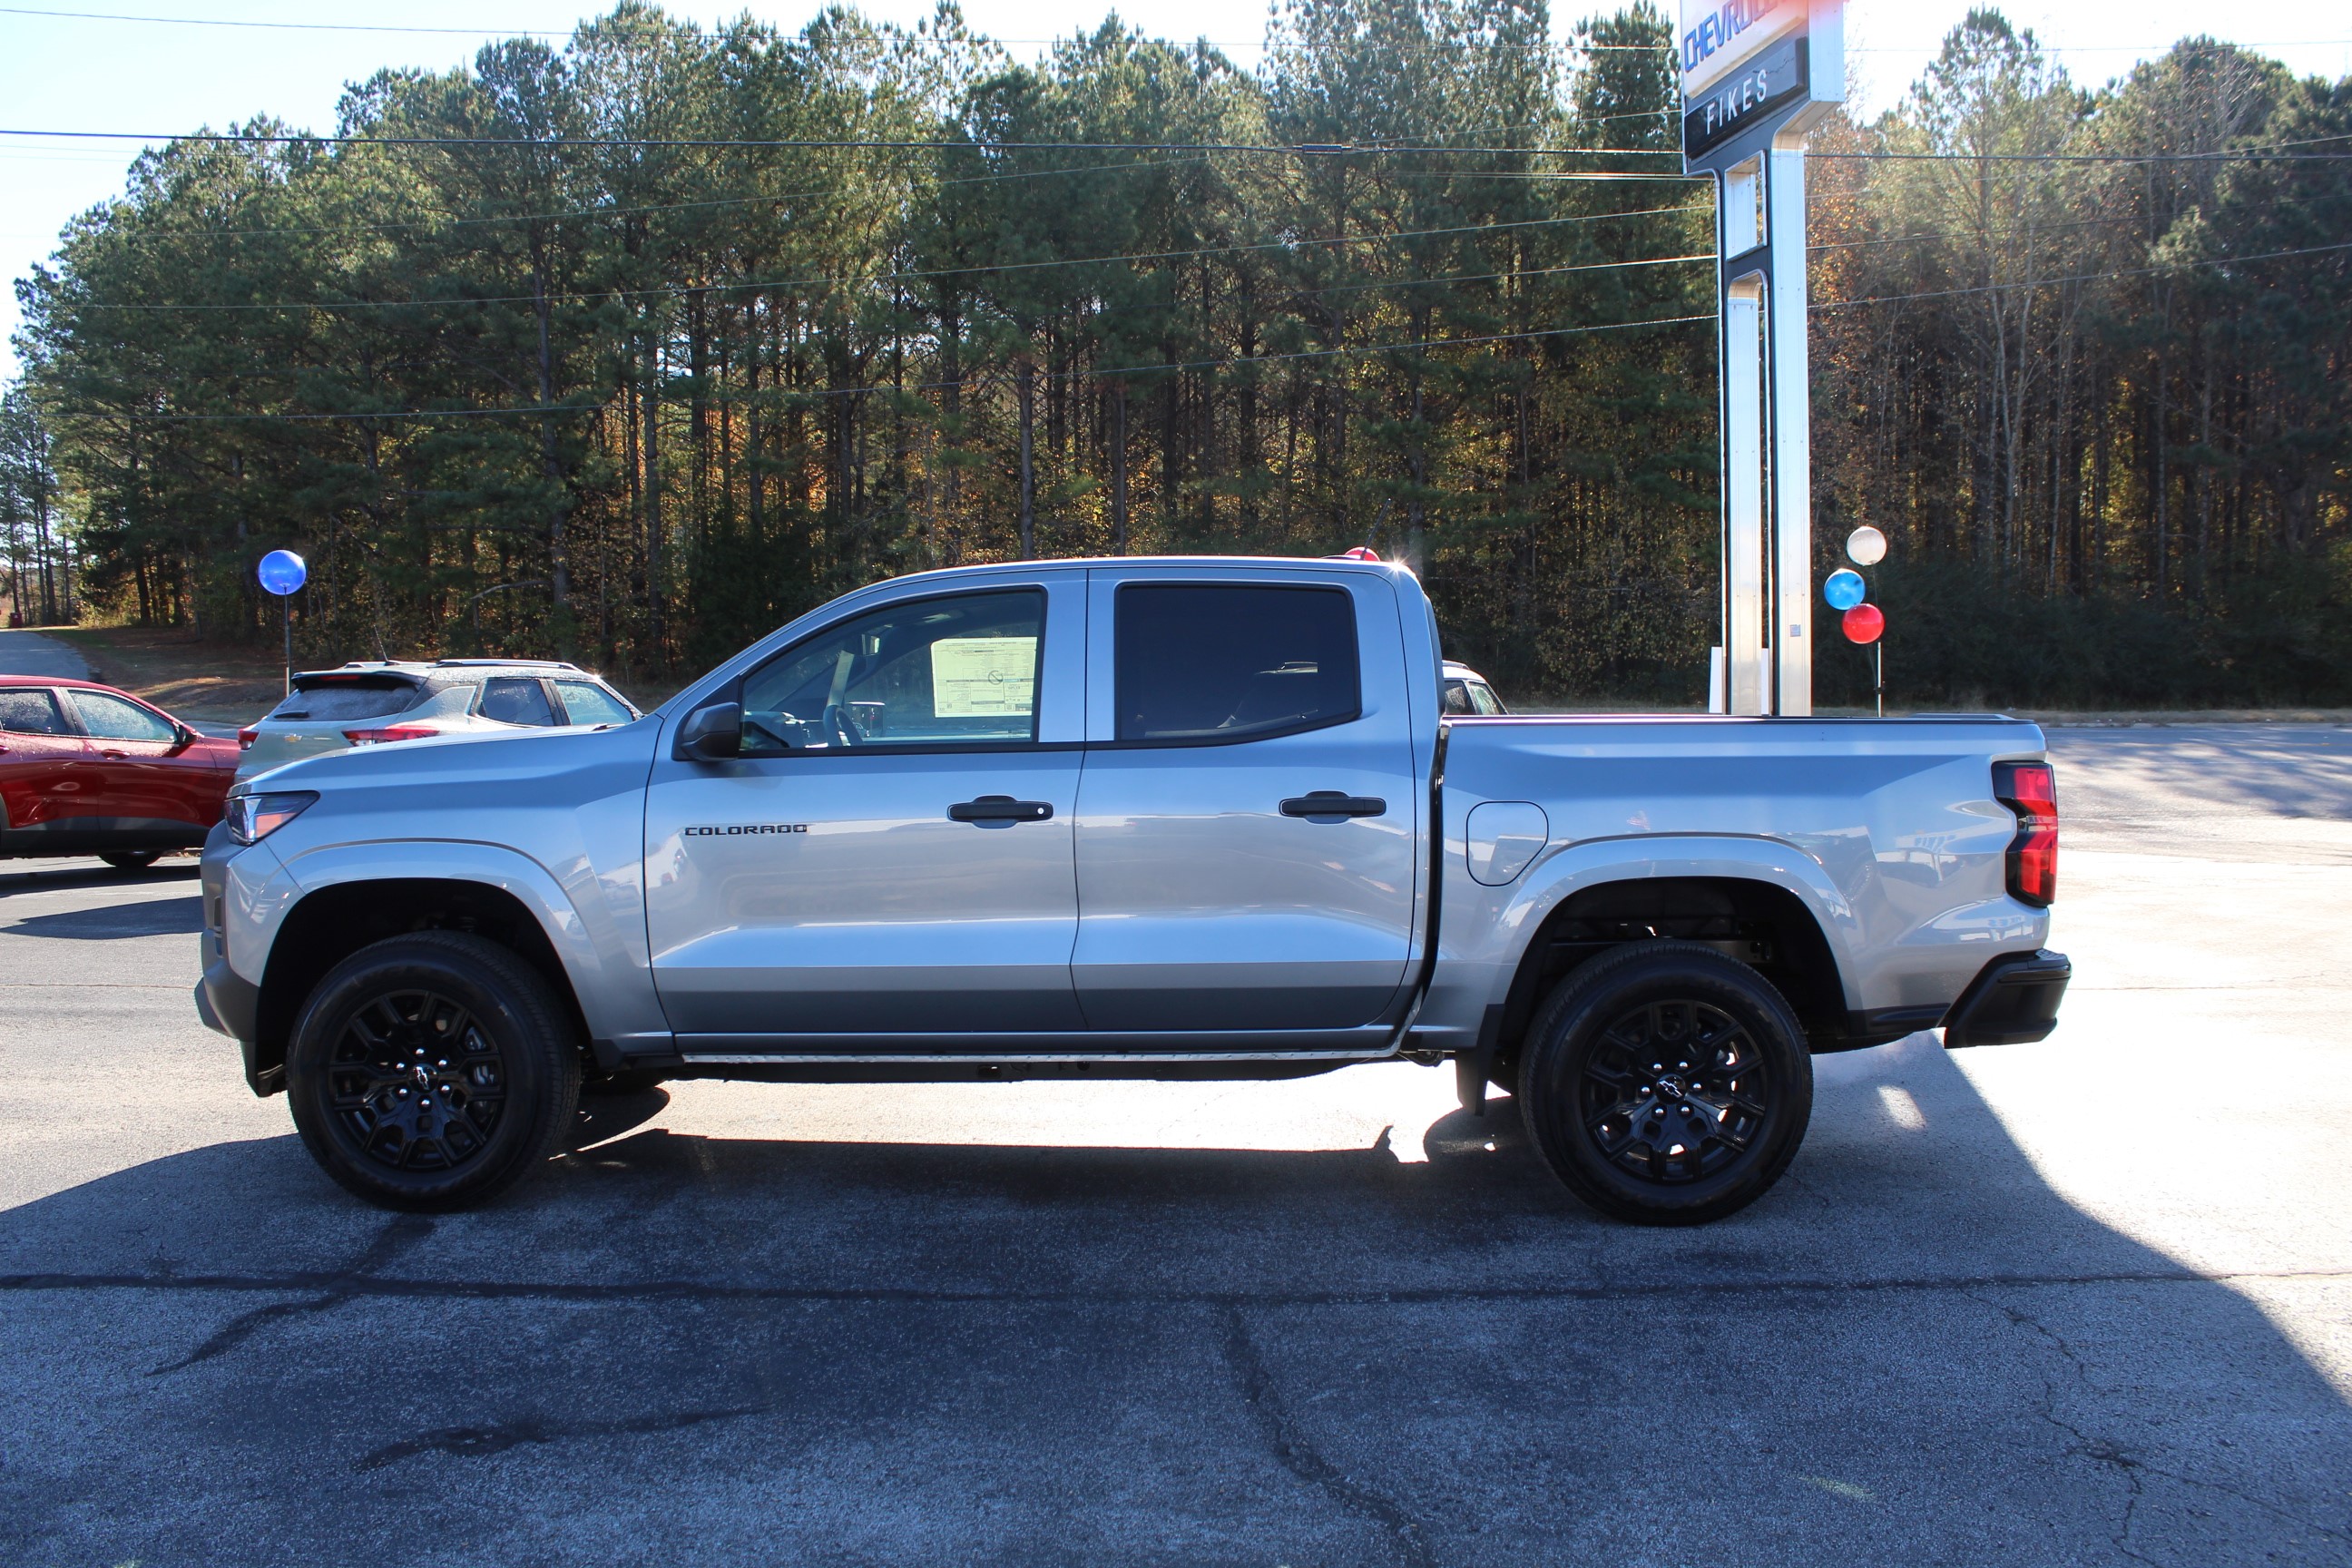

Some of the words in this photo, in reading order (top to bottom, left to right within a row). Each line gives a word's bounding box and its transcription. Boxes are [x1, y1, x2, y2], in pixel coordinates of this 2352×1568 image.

[1683, 0, 1779, 73] CHEVROL
[1706, 68, 1768, 135] FIKES
[684, 824, 808, 837] COLORADO
